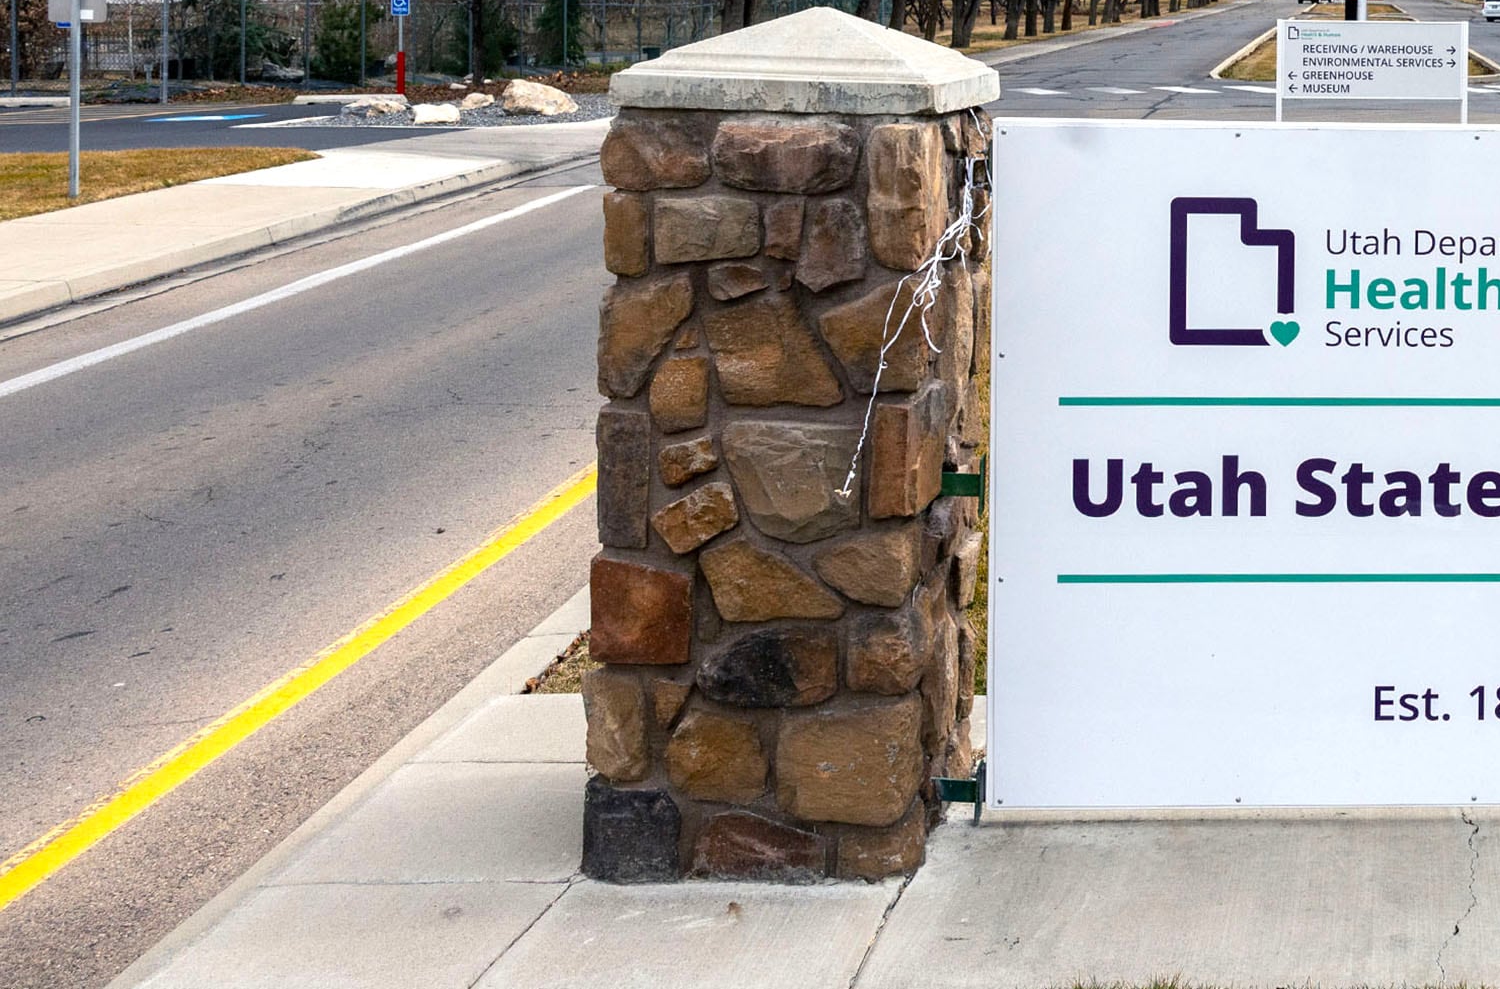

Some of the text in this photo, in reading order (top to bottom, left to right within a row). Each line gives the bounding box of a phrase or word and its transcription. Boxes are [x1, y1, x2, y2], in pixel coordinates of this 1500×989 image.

[1303, 44, 1358, 54] RECEIVING
[1367, 45, 1433, 55] WAREHOUSE
[1303, 57, 1443, 68] ENVIRONMENTAL SERVICES
[1302, 70, 1374, 81] GREENHOUSE
[1302, 83, 1350, 94] MUSEUM
[1325, 228, 1402, 256] Utah
[1324, 319, 1455, 349] Services
[1072, 454, 1268, 518] Utah
[1373, 685, 1451, 723] Est.
